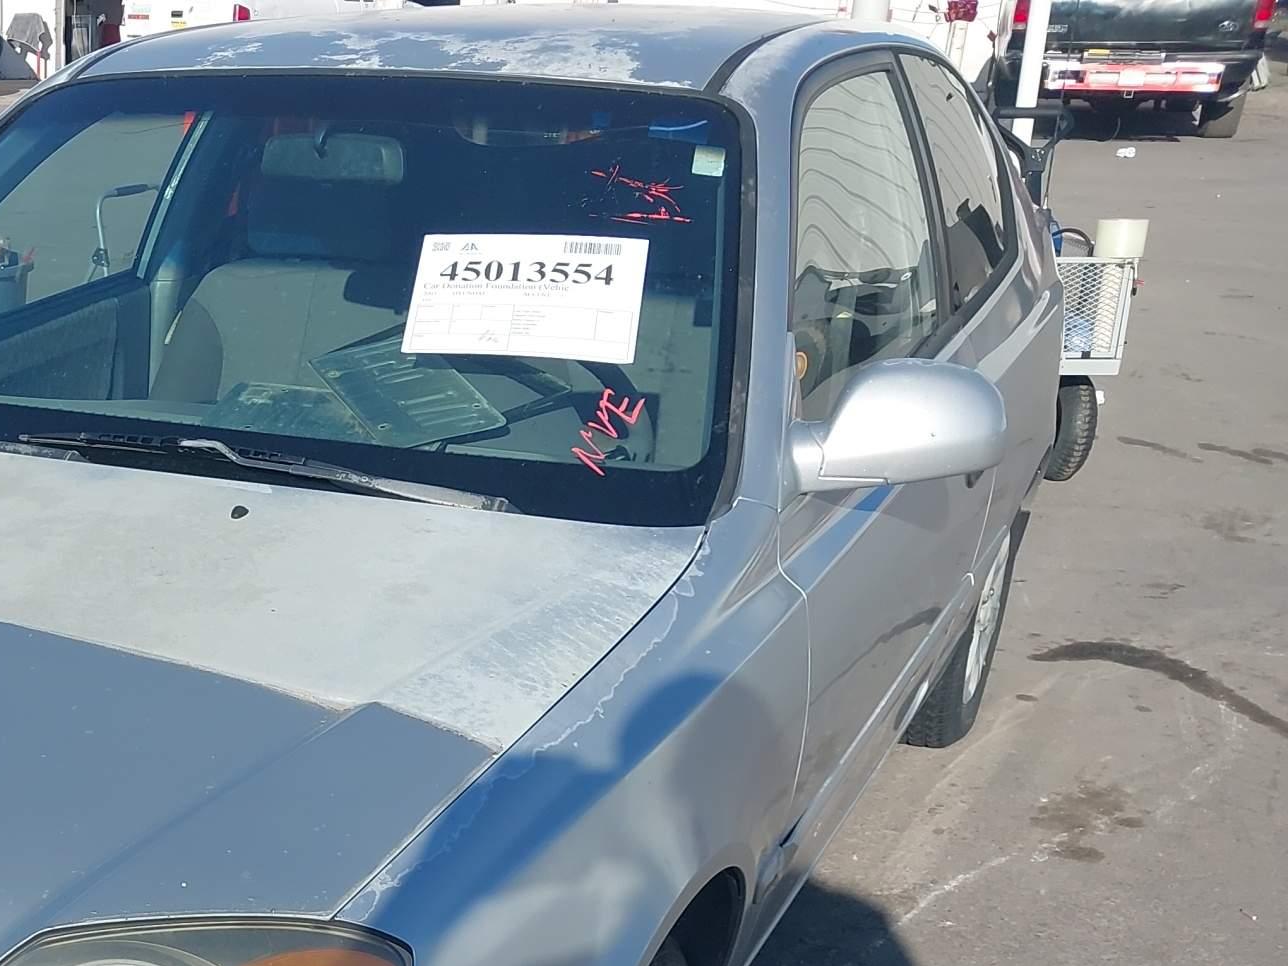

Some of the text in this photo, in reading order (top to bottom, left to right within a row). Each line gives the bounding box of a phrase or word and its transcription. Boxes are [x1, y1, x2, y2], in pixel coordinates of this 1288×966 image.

[440, 260, 614, 286] 45013554
[423, 282, 439, 290] Car
[442, 282, 483, 290] Donation
